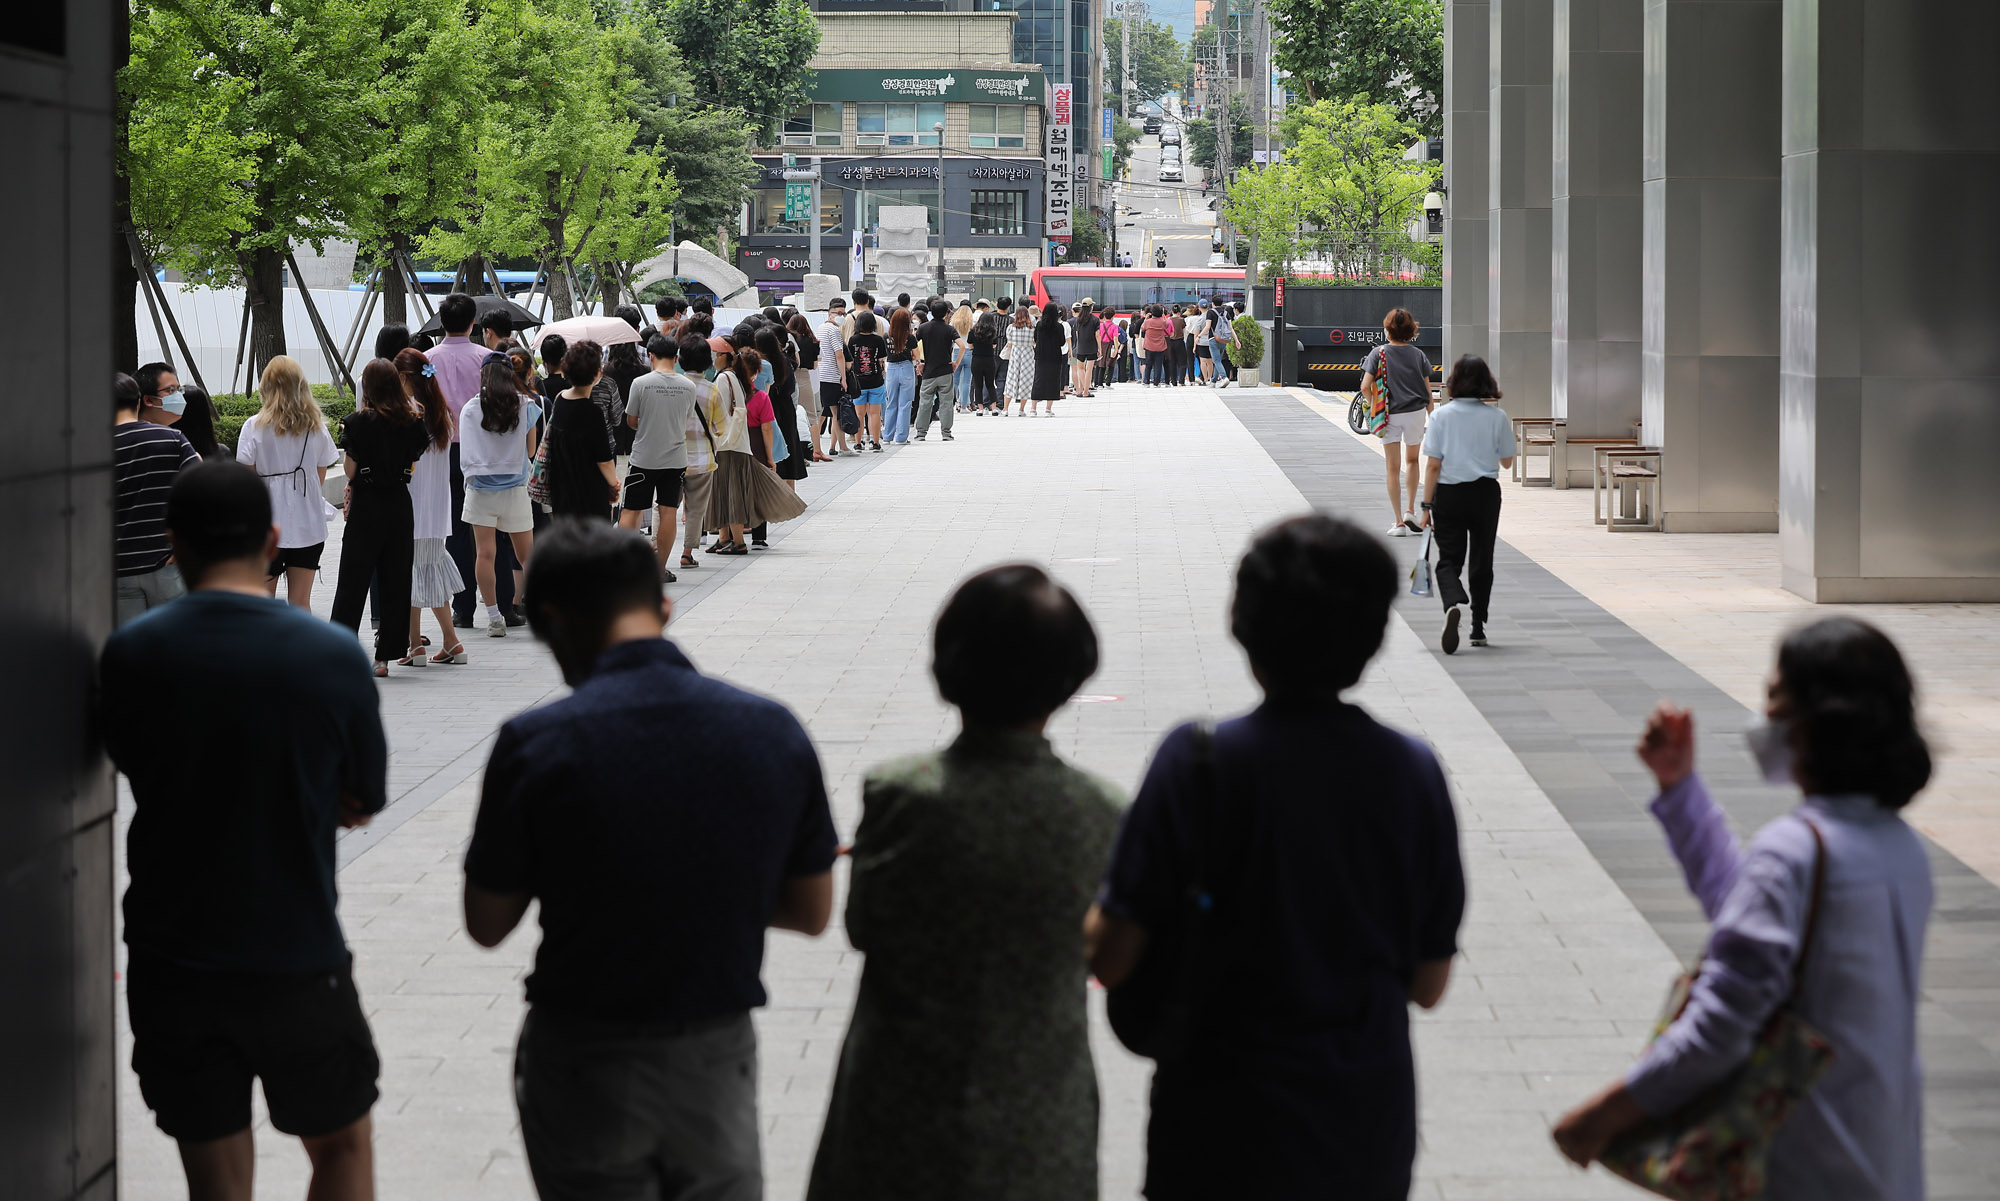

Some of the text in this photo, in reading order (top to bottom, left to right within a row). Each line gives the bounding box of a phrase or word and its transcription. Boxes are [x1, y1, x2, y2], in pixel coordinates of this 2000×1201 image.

[882, 79, 937, 89] 삼성경희한의원
[976, 79, 1016, 90] 삼성경희한의원
[1055, 89, 1071, 125] 상품권
[973, 167, 1032, 181] 자기치아살리기
[783, 259, 823, 271] SQUA
[1347, 331, 1383, 342] 진입금지
